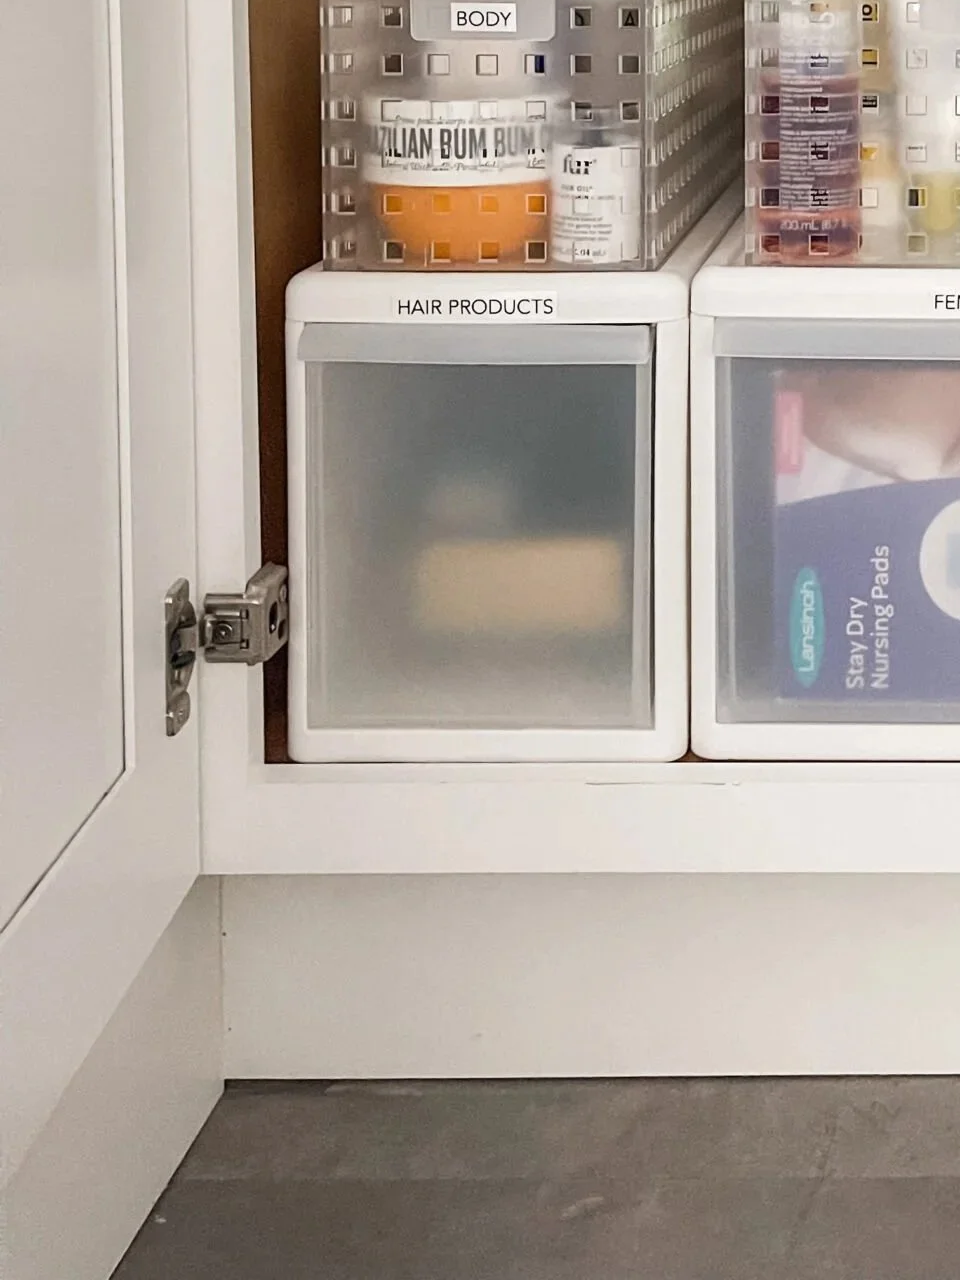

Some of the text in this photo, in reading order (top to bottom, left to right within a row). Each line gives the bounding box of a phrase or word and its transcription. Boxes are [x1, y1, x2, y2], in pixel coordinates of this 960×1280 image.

[456, 10, 512, 27] BODY
[439, 127, 487, 160] BUM
[563, 154, 592, 175] fur
[398, 298, 554, 315] HAIR PRODUCTS
[798, 580, 815, 673] Lansinoh
[869, 544, 895, 690] Nursing Pads
[845, 596, 868, 690] Stay Dry
